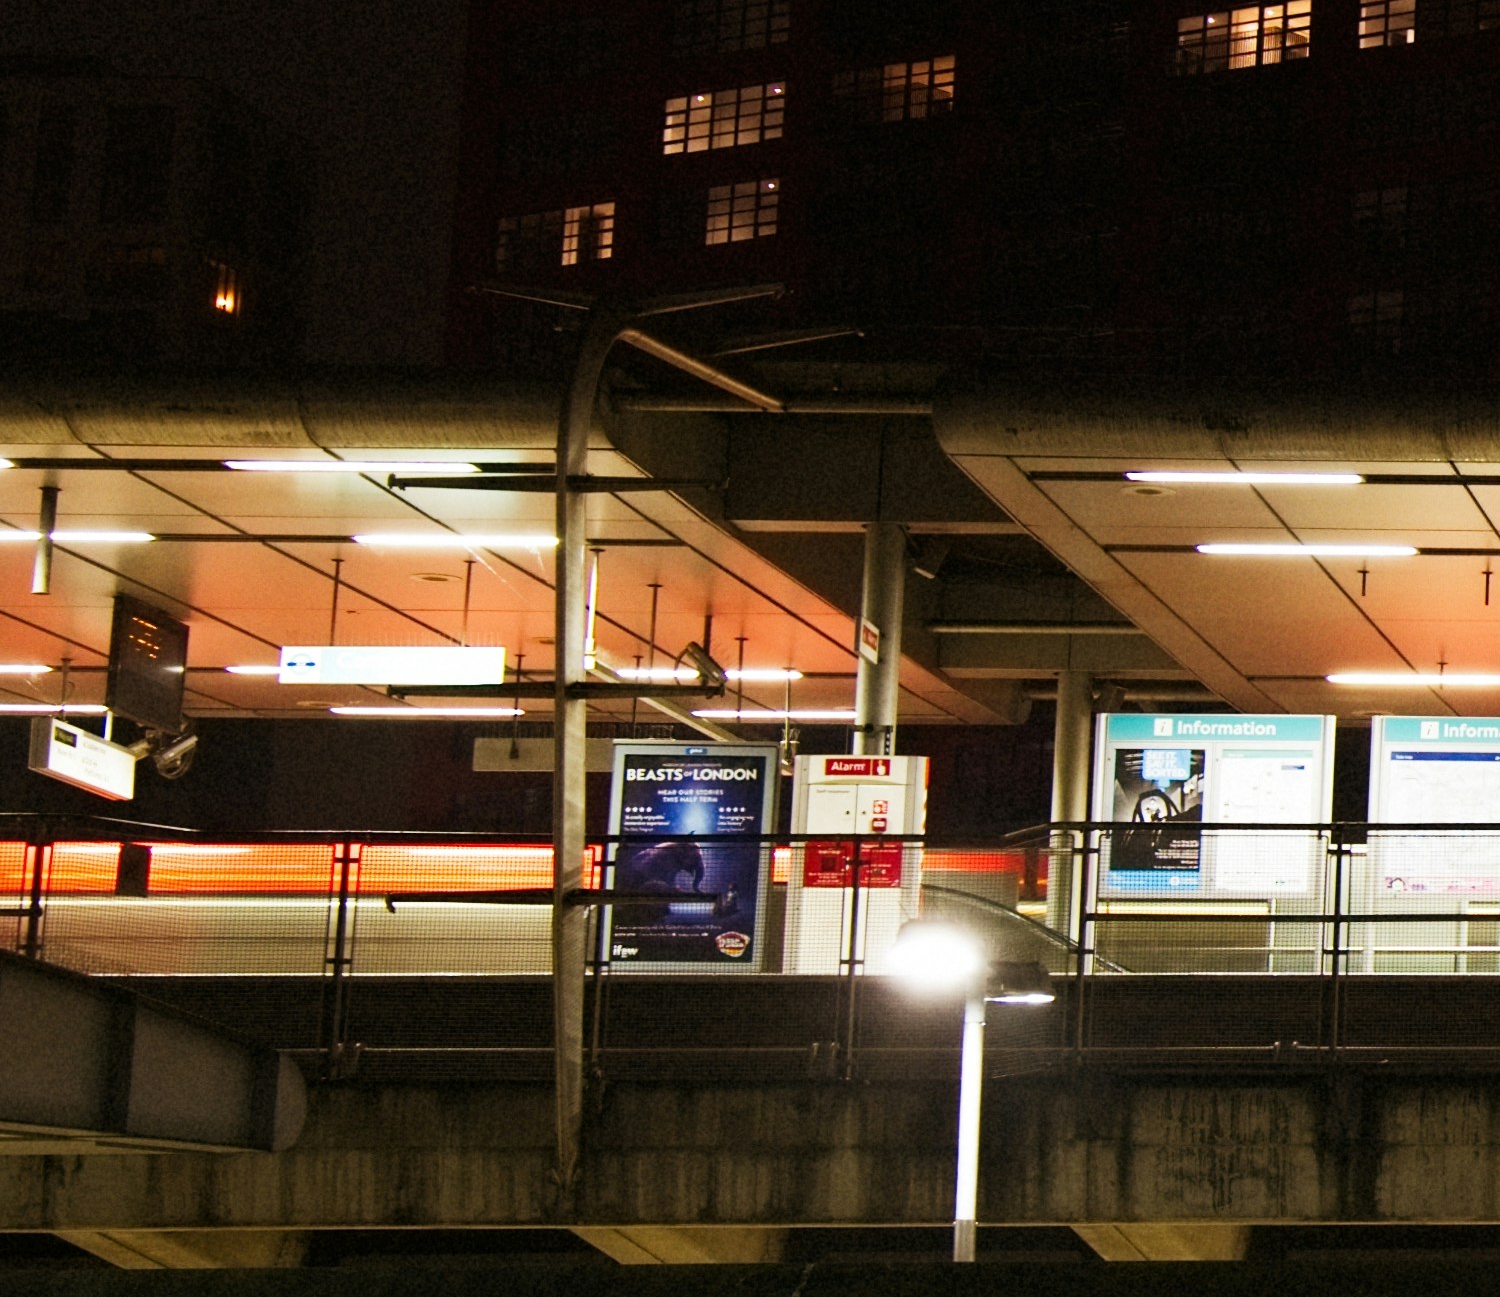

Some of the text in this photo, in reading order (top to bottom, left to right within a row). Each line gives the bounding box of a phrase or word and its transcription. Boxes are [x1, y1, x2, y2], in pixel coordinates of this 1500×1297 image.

[1177, 720, 1277, 736] Information
[831, 761, 866, 772] Alarm
[626, 768, 684, 781] BEASTS
[693, 768, 758, 781] LONDON
